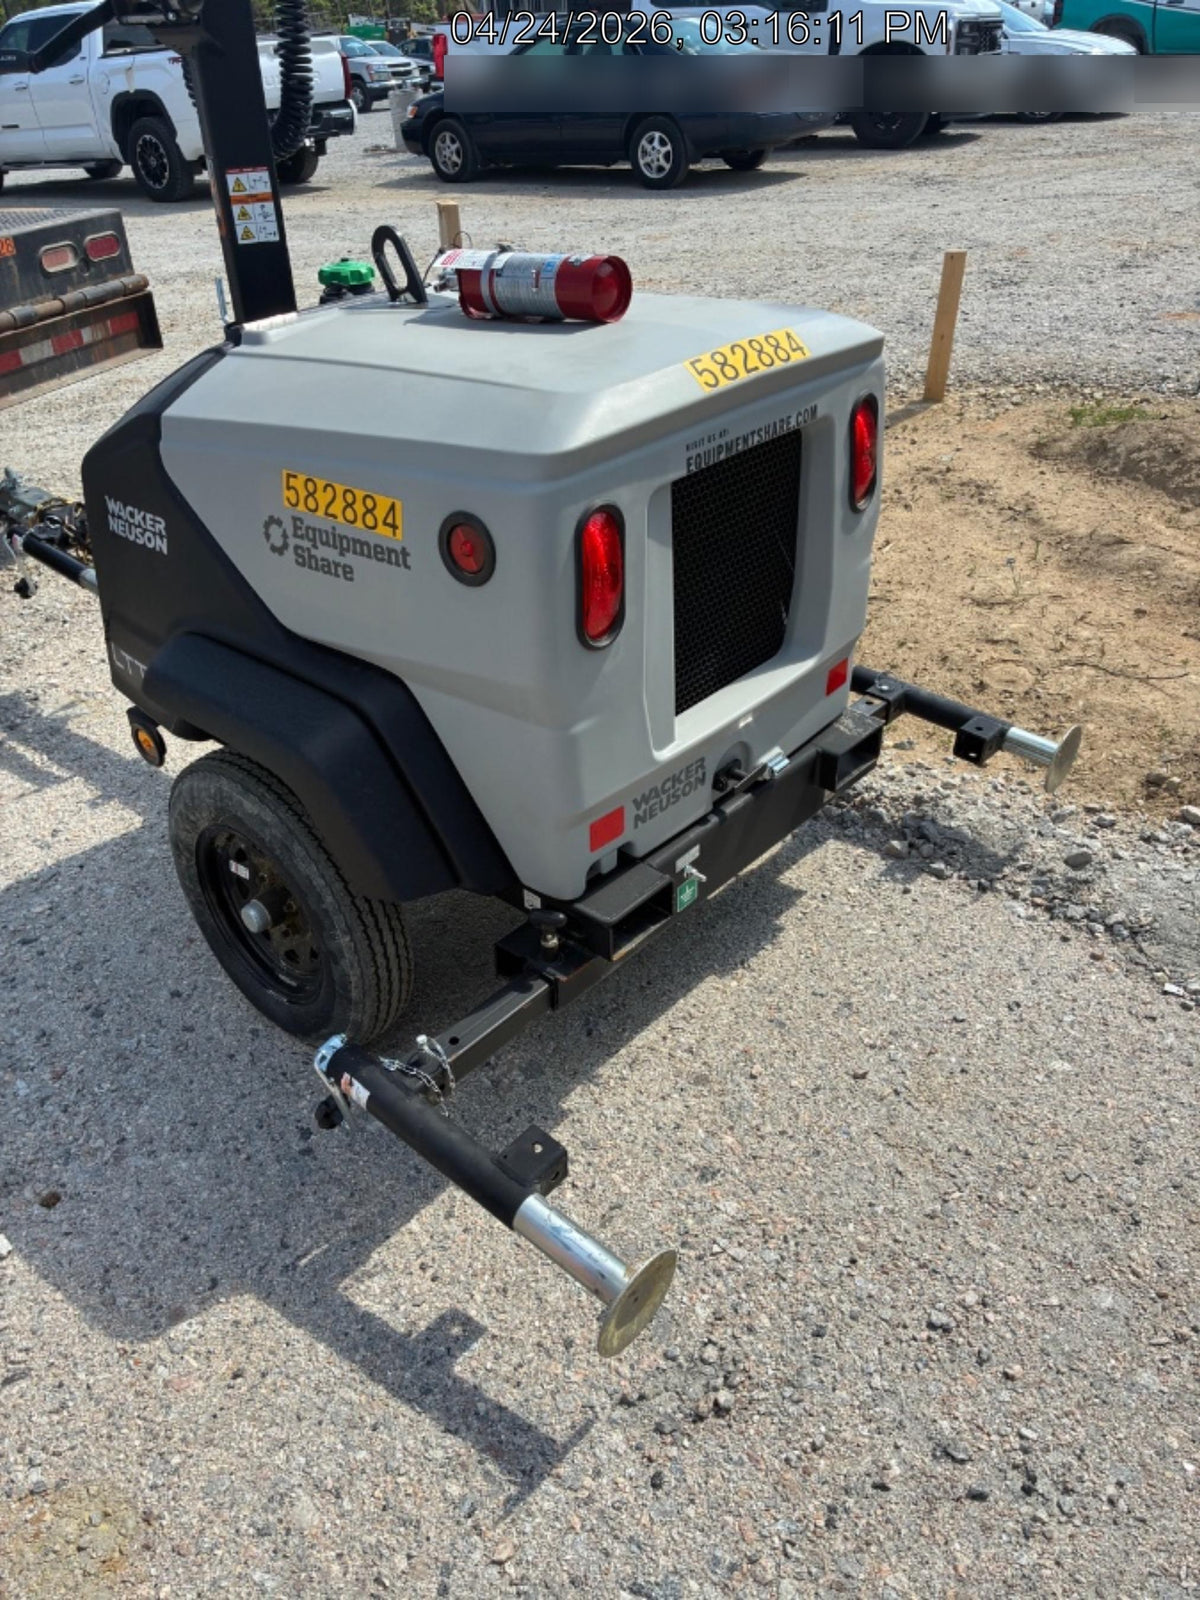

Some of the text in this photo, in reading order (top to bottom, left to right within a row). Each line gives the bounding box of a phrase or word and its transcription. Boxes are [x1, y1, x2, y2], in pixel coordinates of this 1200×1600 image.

[689, 330, 806, 388] 582884
[686, 404, 818, 474] EQUIPMENTSHARE.COM
[104, 495, 167, 536] WACKER
[285, 472, 399, 537] 582884
[108, 514, 168, 556] NEUSON
[291, 516, 411, 570] Equipment
[294, 544, 355, 582] Share
[632, 757, 706, 811] WACKER
[633, 771, 706, 829] NEUSON
